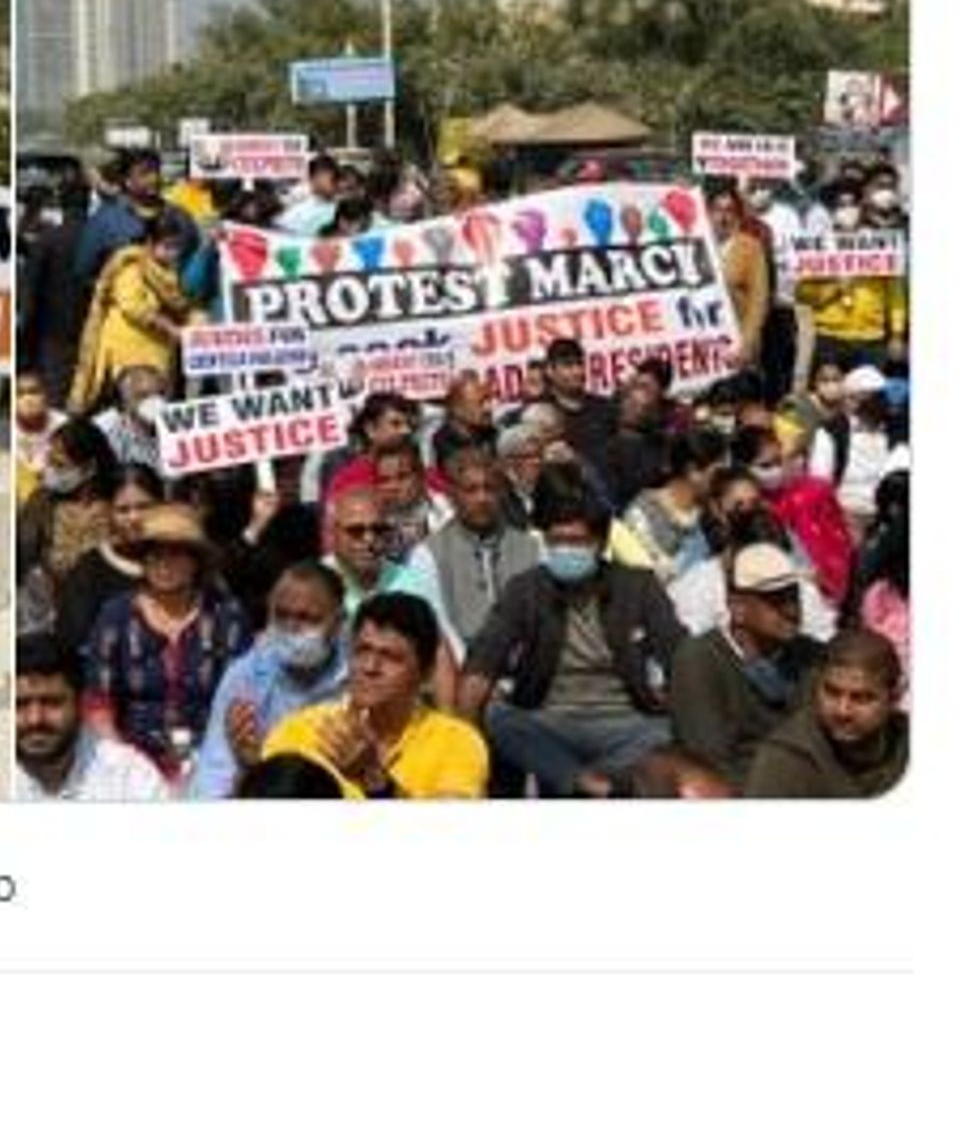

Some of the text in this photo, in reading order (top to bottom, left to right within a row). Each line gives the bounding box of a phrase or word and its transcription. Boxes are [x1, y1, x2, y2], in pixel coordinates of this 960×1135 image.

[246, 264, 510, 324] PROTEST
[471, 300, 664, 355] JUSTICE
[163, 402, 220, 433] WE
[232, 384, 333, 422] WANT
[168, 414, 340, 467] JUSTICE
